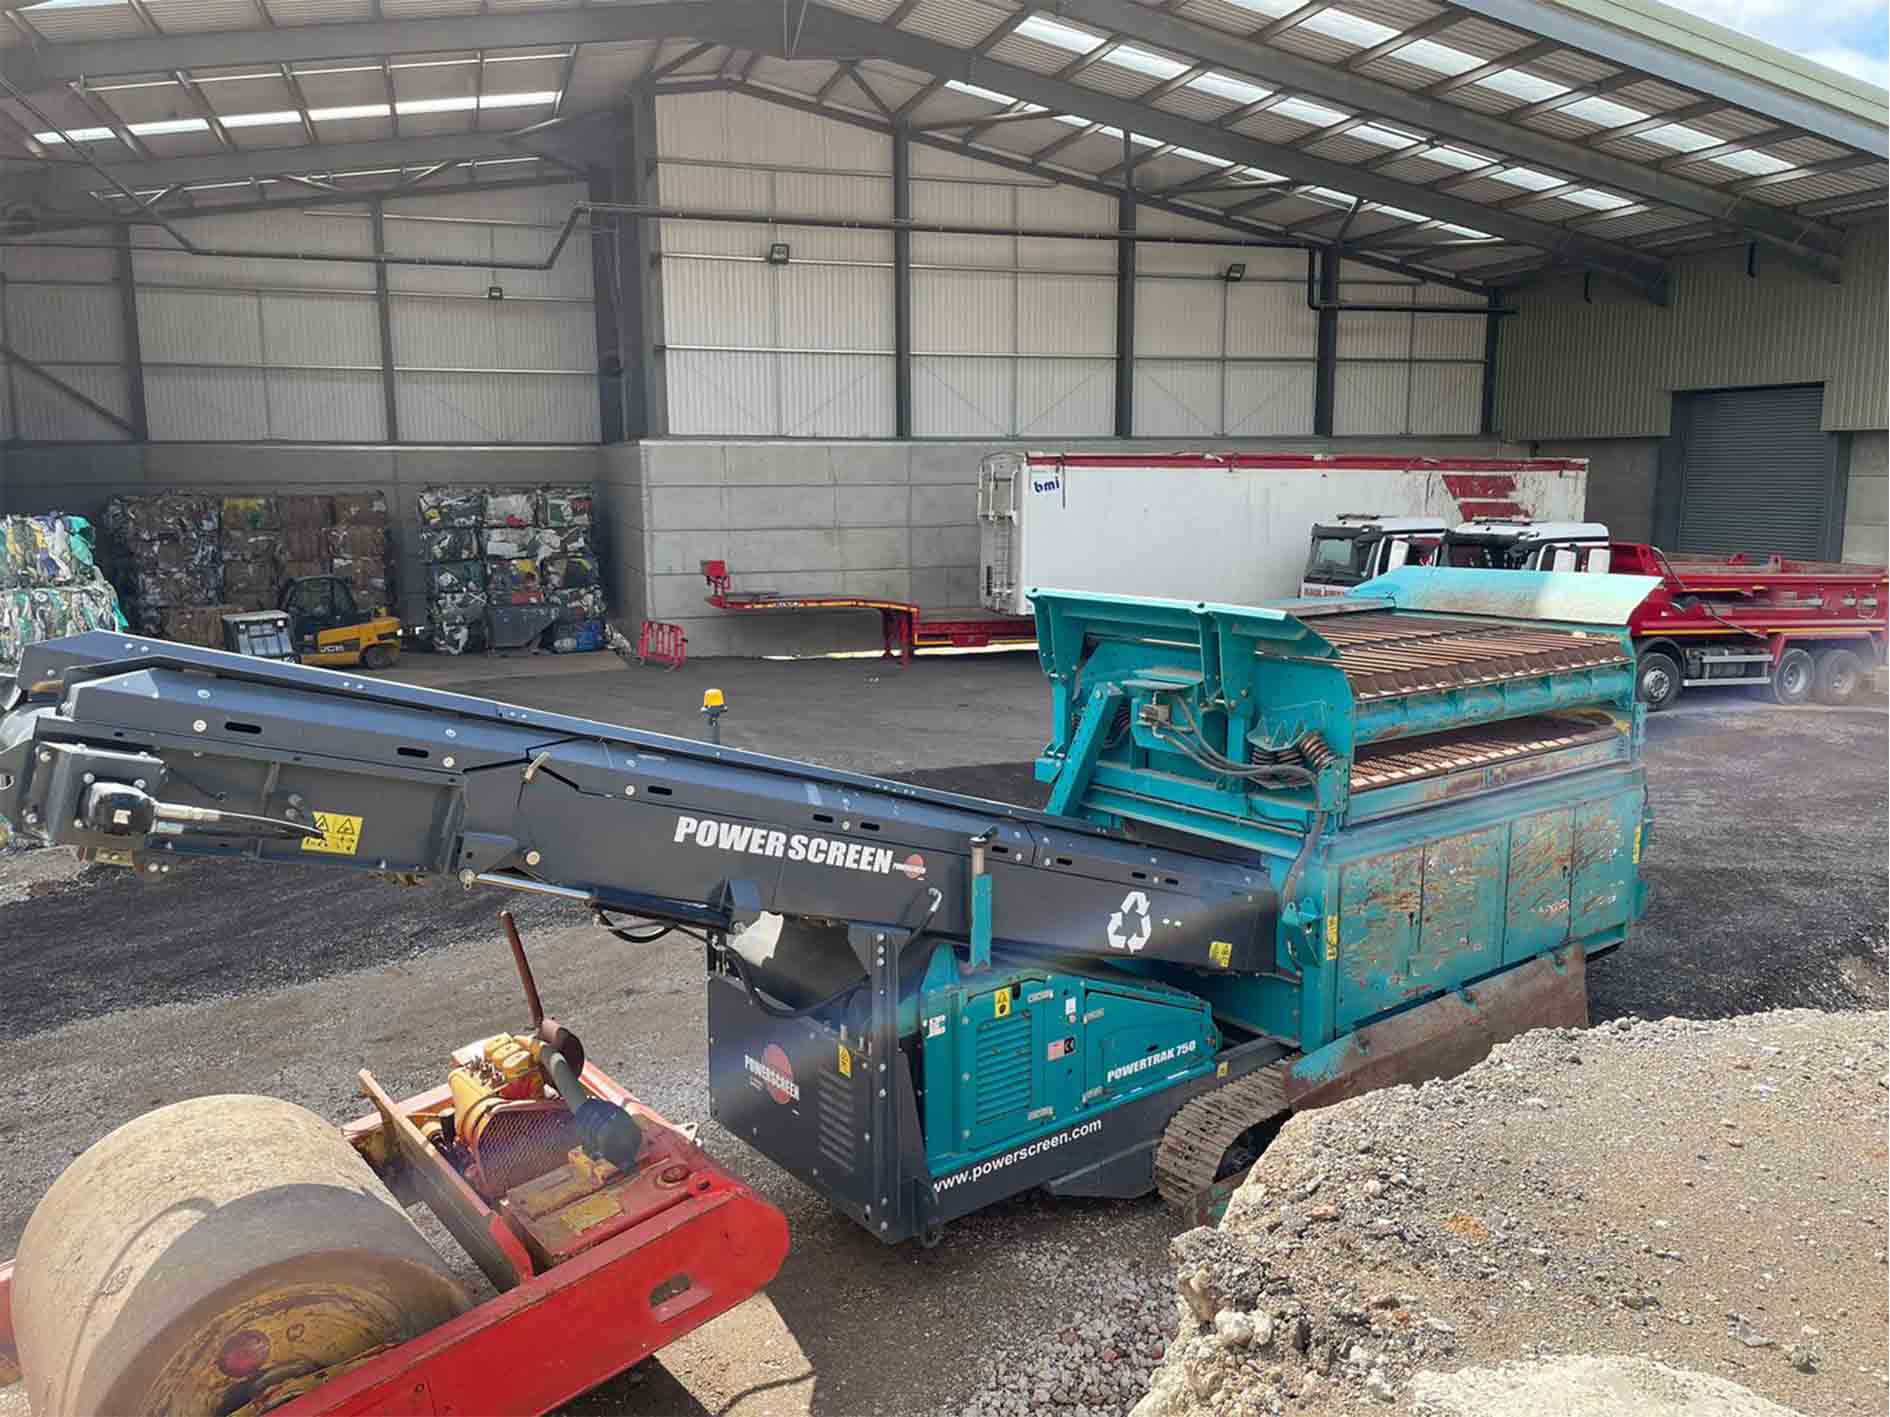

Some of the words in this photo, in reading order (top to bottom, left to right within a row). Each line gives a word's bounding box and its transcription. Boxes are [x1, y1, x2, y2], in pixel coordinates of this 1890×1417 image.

[1033, 475, 1060, 493] bmi
[673, 816, 894, 875] POWERSCREEN
[1107, 1048, 1175, 1083] POWERTRAK
[1176, 1040, 1196, 1056] 750
